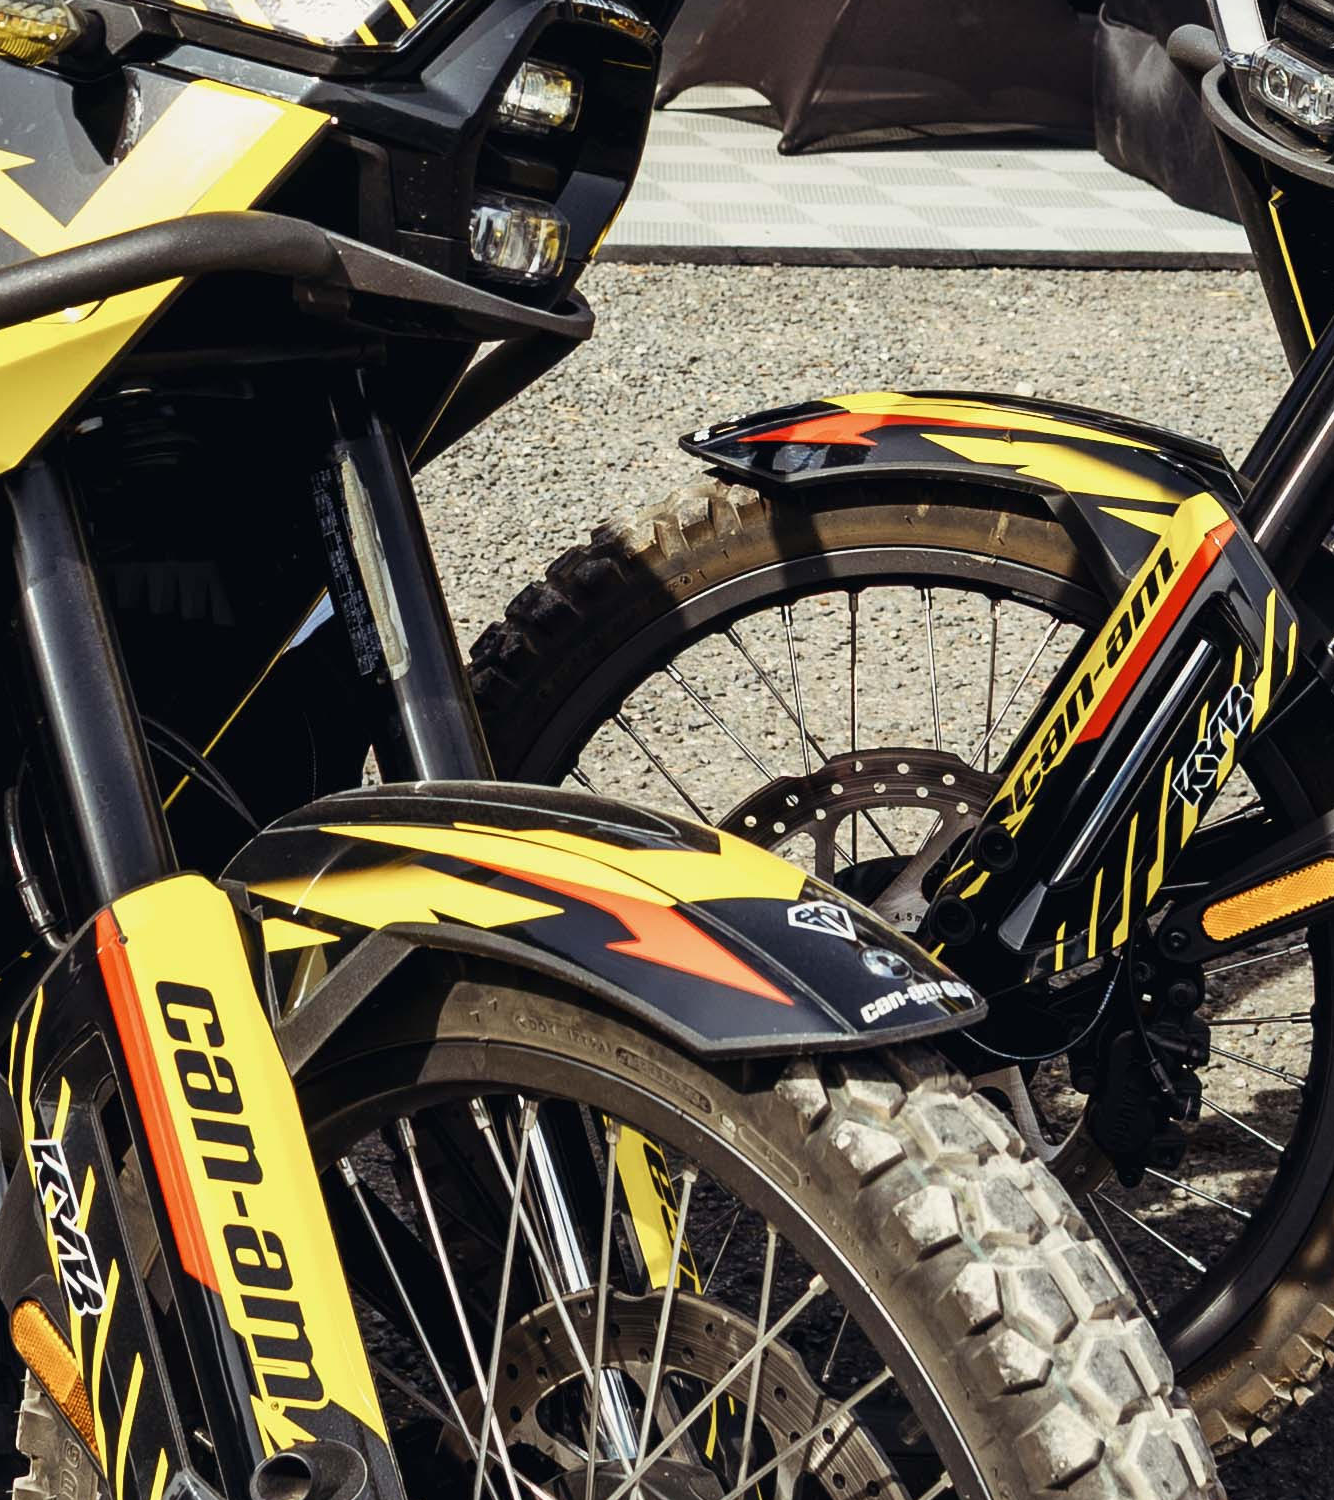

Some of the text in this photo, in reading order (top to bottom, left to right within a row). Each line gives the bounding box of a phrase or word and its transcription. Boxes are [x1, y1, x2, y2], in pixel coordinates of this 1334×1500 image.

[1013, 545, 1174, 813] can-am
[1171, 683, 1255, 808] KYB
[859, 981, 943, 1024] can-am
[155, 978, 328, 1402] can-am
